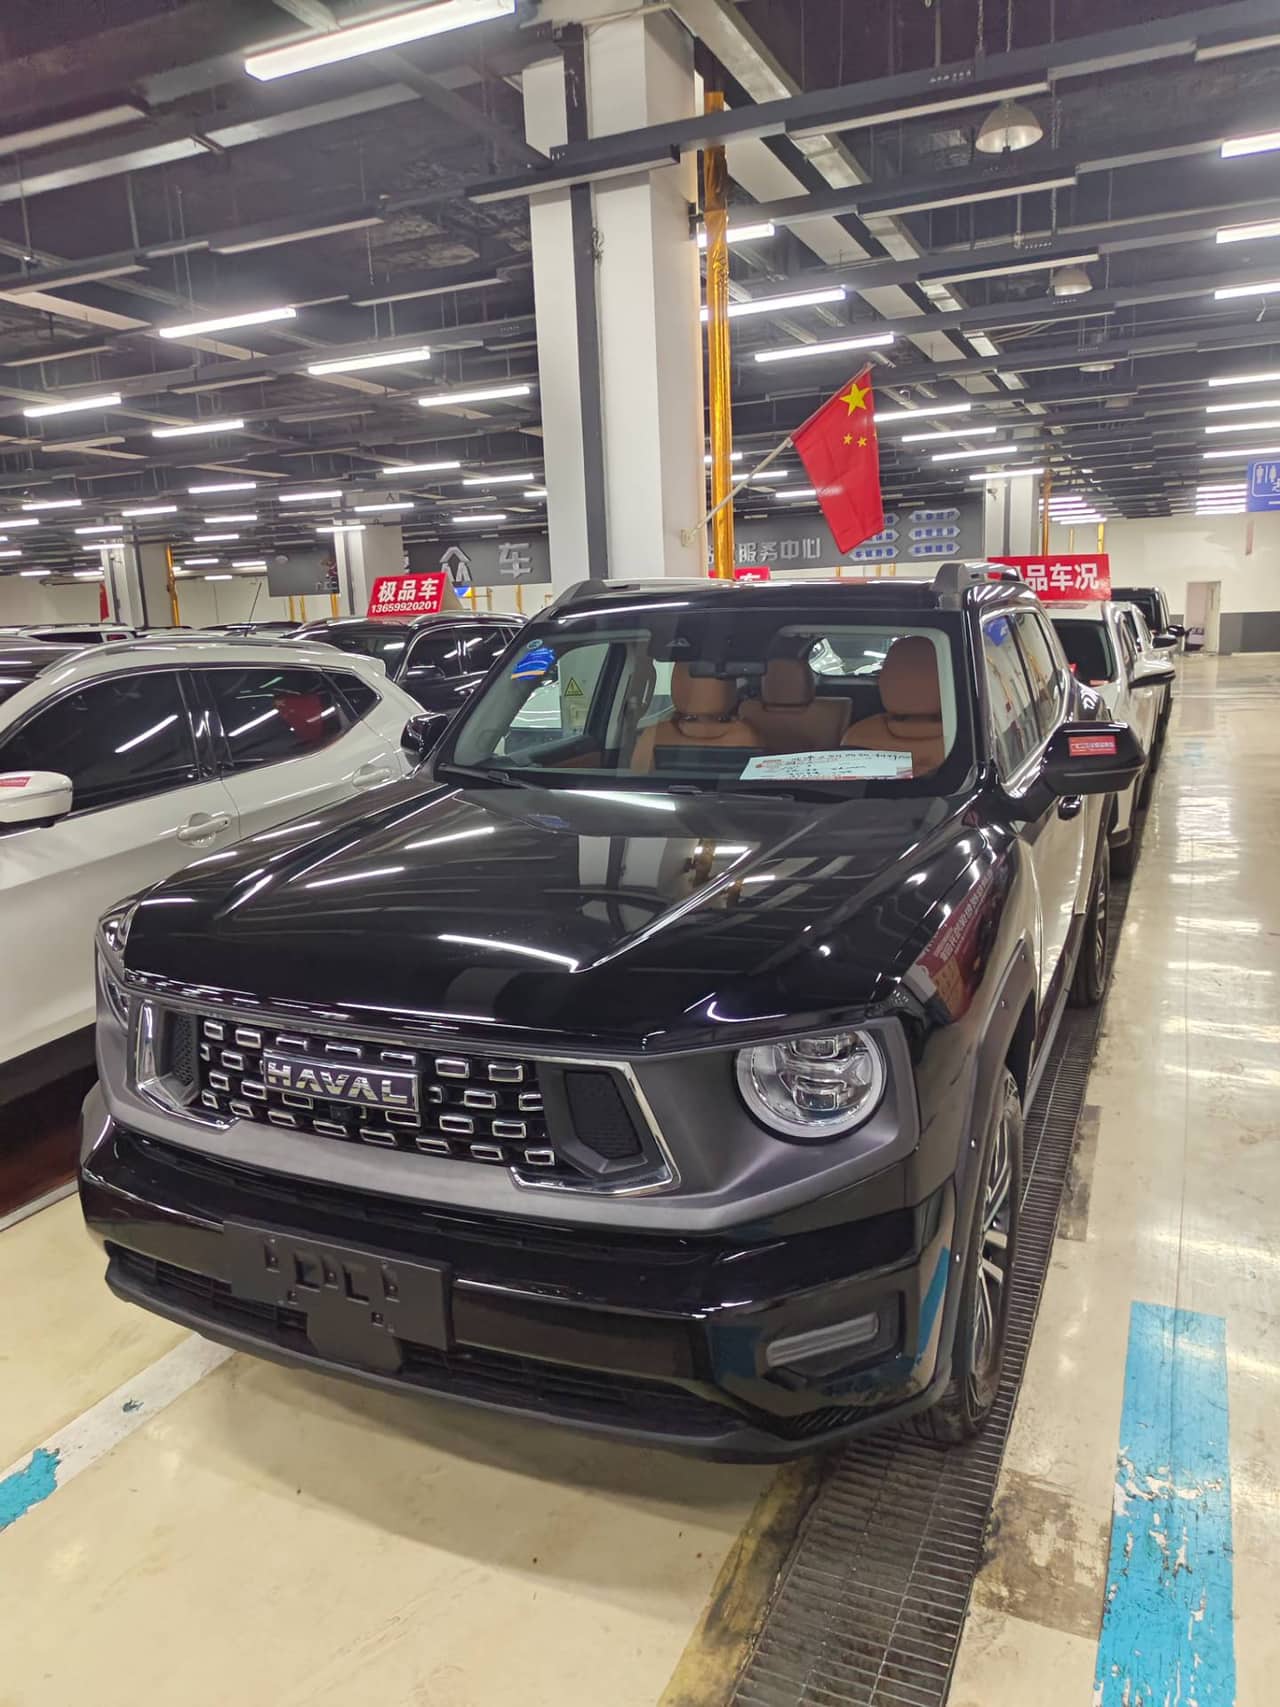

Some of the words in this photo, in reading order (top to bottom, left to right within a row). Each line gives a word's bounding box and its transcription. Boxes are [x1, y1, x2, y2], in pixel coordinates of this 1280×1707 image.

[708, 537, 821, 564] 服务中心
[378, 578, 439, 602] 极品车
[1016, 563, 1099, 592] 品车况
[371, 601, 437, 613] 13659920201
[267, 1062, 408, 1104] HAVAL
